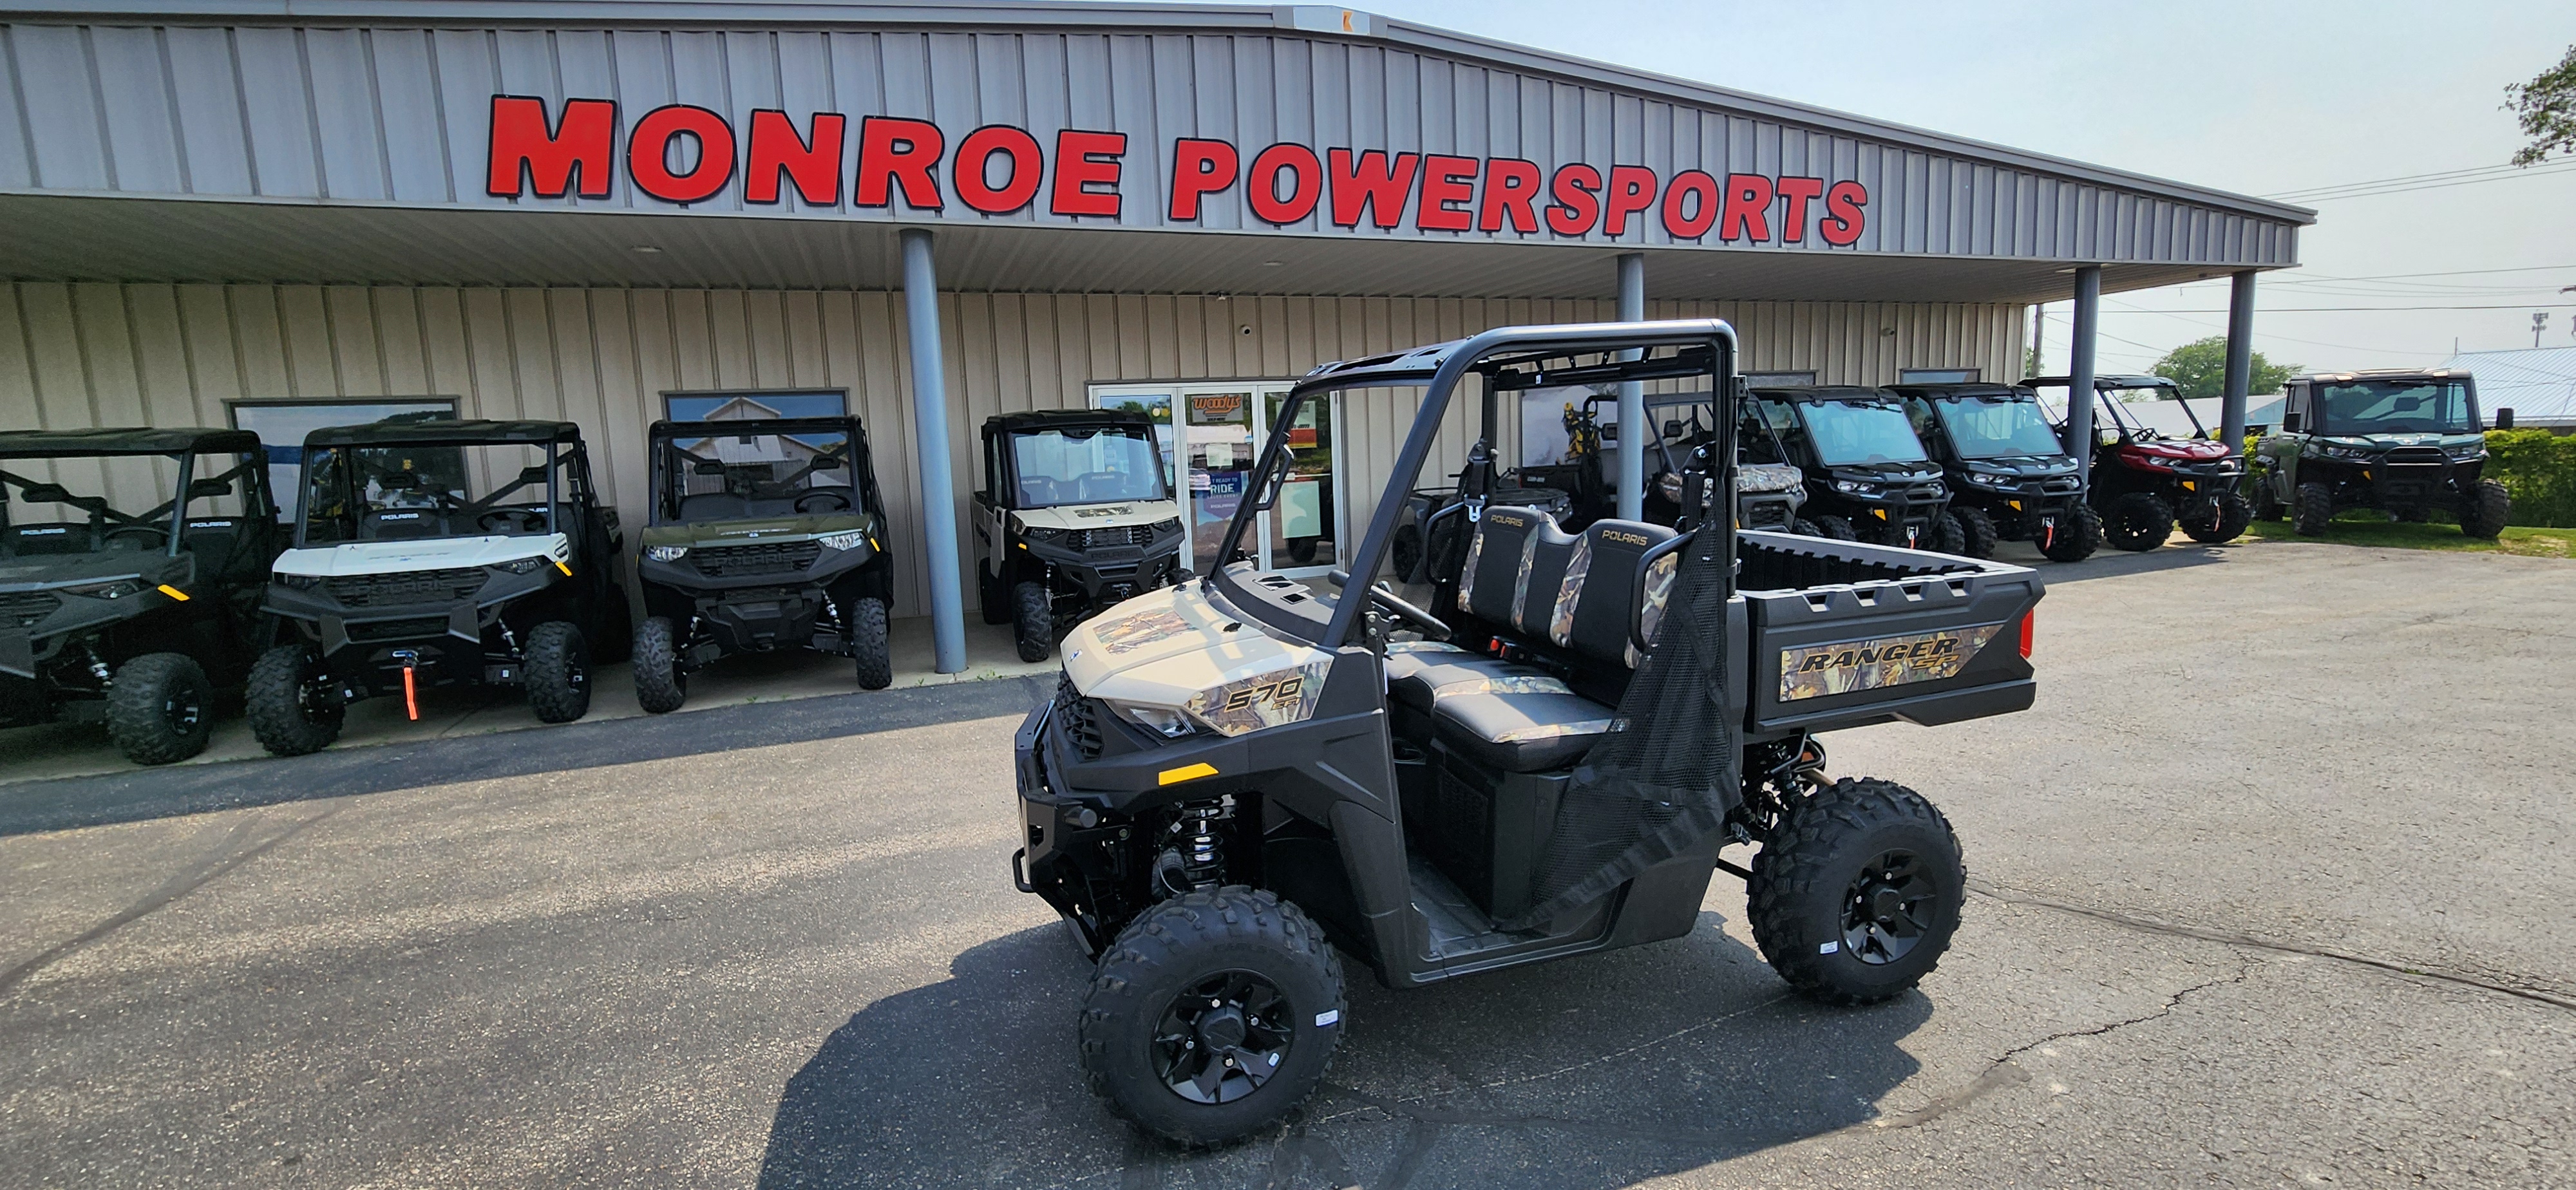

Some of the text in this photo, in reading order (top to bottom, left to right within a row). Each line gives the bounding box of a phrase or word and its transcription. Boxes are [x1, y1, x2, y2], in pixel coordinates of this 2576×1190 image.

[486, 94, 1868, 247] MONROE POWERSPORTS
[1211, 483, 1235, 494] RIDE
[1491, 515, 1523, 527] POLARIS
[1602, 529, 1648, 546] POLARIS
[1798, 637, 1960, 674] RANGER
[1910, 654, 1960, 670] SP
[1224, 677, 1305, 713] 570
[1271, 698, 1301, 710] EFI
